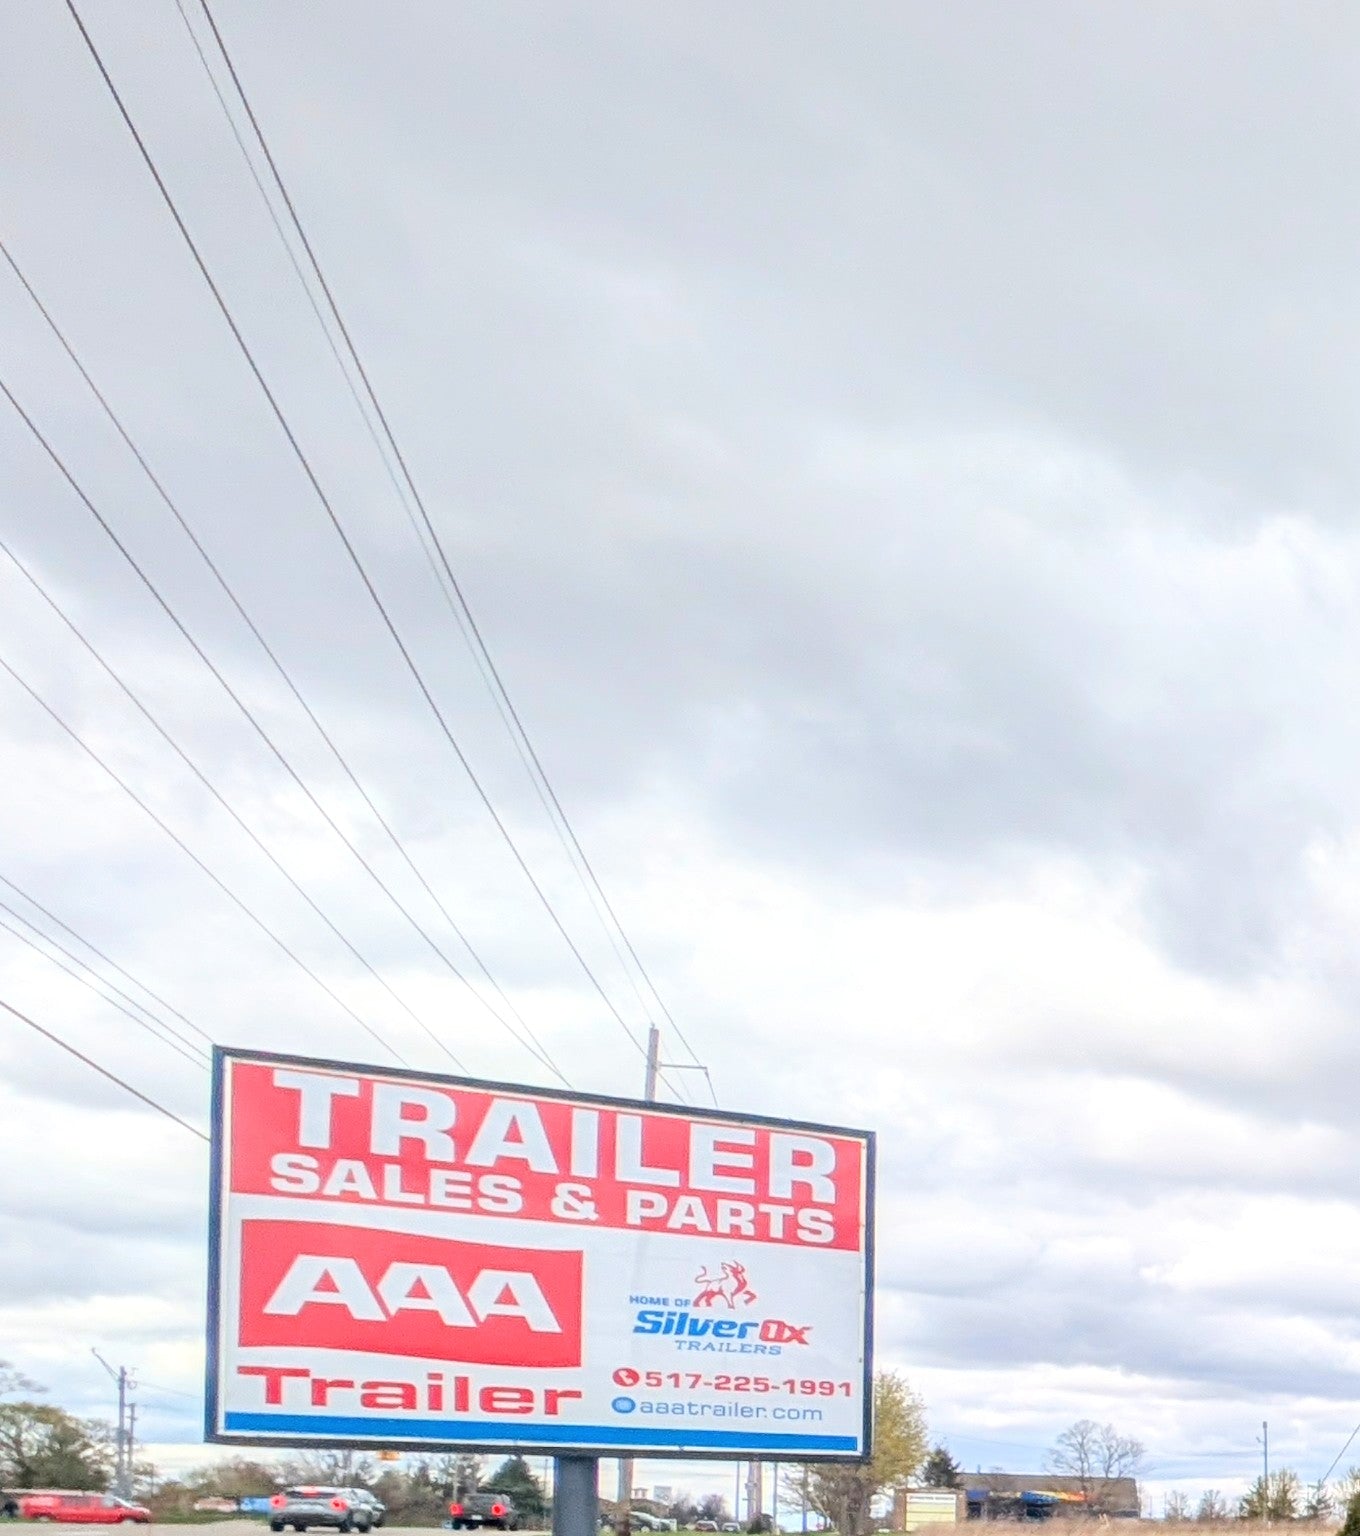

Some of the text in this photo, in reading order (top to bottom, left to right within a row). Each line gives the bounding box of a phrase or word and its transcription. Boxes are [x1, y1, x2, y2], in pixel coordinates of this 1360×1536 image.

[273, 1069, 839, 1204] TRAILER
[270, 1153, 835, 1244] SALES & PARTS
[264, 1254, 563, 1334] AAA
[629, 1295, 692, 1308] HOME OF
[675, 1340, 782, 1356] TRAILERS
[237, 1366, 582, 1416] Trailer
[645, 1371, 852, 1398] 517-225-1991
[640, 1401, 823, 1421] aaatrailer.com
